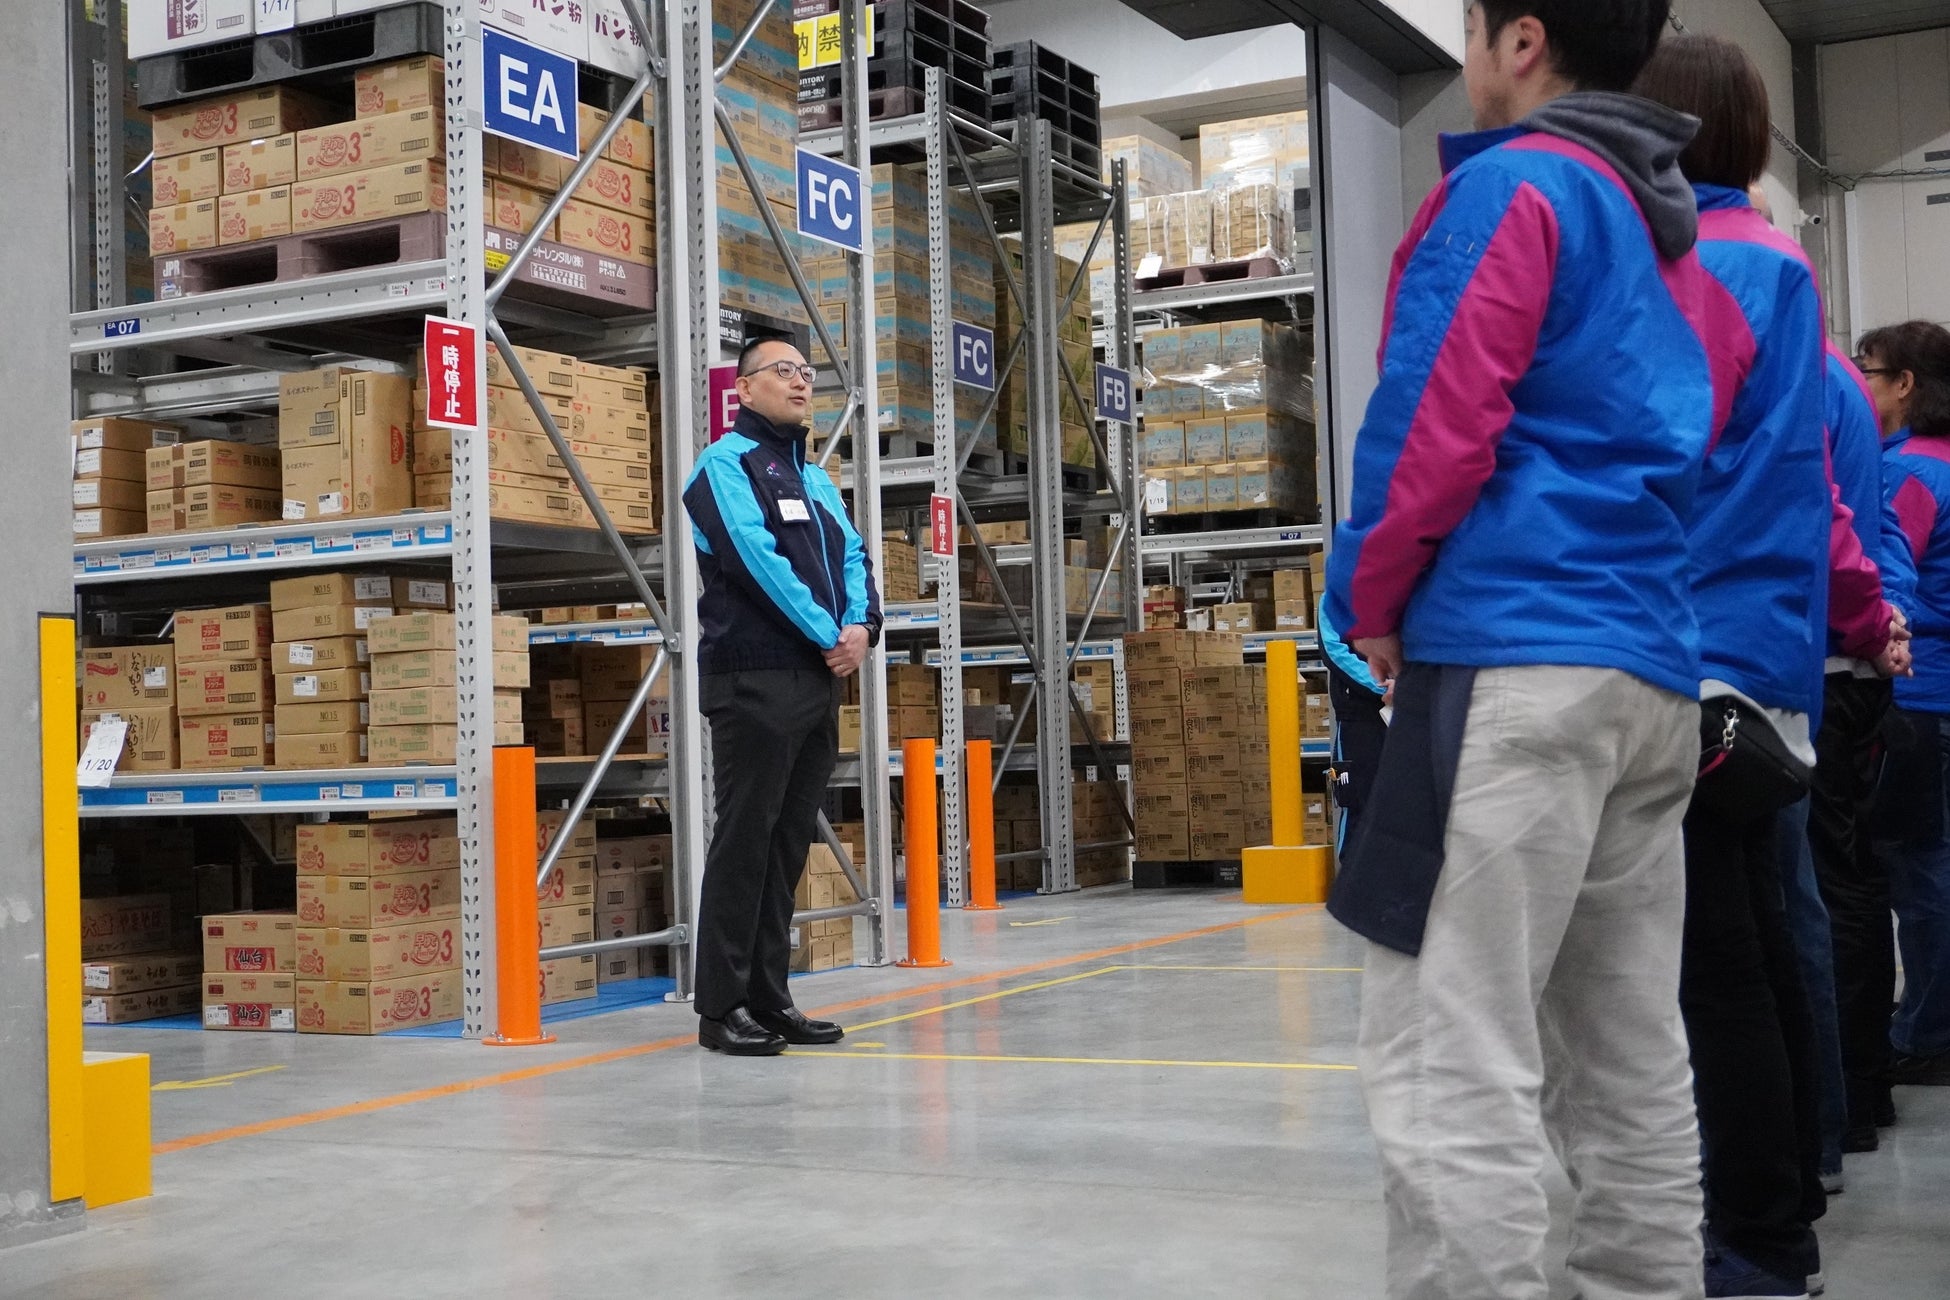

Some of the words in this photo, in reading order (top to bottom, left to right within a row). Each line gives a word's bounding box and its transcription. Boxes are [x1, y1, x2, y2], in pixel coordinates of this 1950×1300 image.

[500, 54, 565, 134] EA
[224, 103, 238, 134] 3
[348, 132, 361, 162] 3
[342, 185, 356, 215] 3
[620, 174, 631, 203] 3
[808, 169, 853, 230] FC
[620, 222, 631, 252] 3
[163, 260, 180, 278] JPR
[119, 319, 136, 335] 07
[959, 334, 988, 376] FC
[442, 327, 461, 419] 一時停止
[1103, 375, 1127, 412] FB
[1149, 497, 1165, 505] 1/19
[938, 499, 947, 552] 一時停止
[1288, 532, 1299, 540] 07
[128, 651, 142, 697] いなりもち
[85, 758, 113, 771] 1/20
[418, 832, 430, 862] 3
[553, 867, 564, 899] 3
[419, 883, 430, 914] 3
[237, 949, 264, 966] 仙台
[440, 929, 453, 962] 3
[237, 1005, 263, 1022] 仙台
[419, 987, 431, 1018] 3
